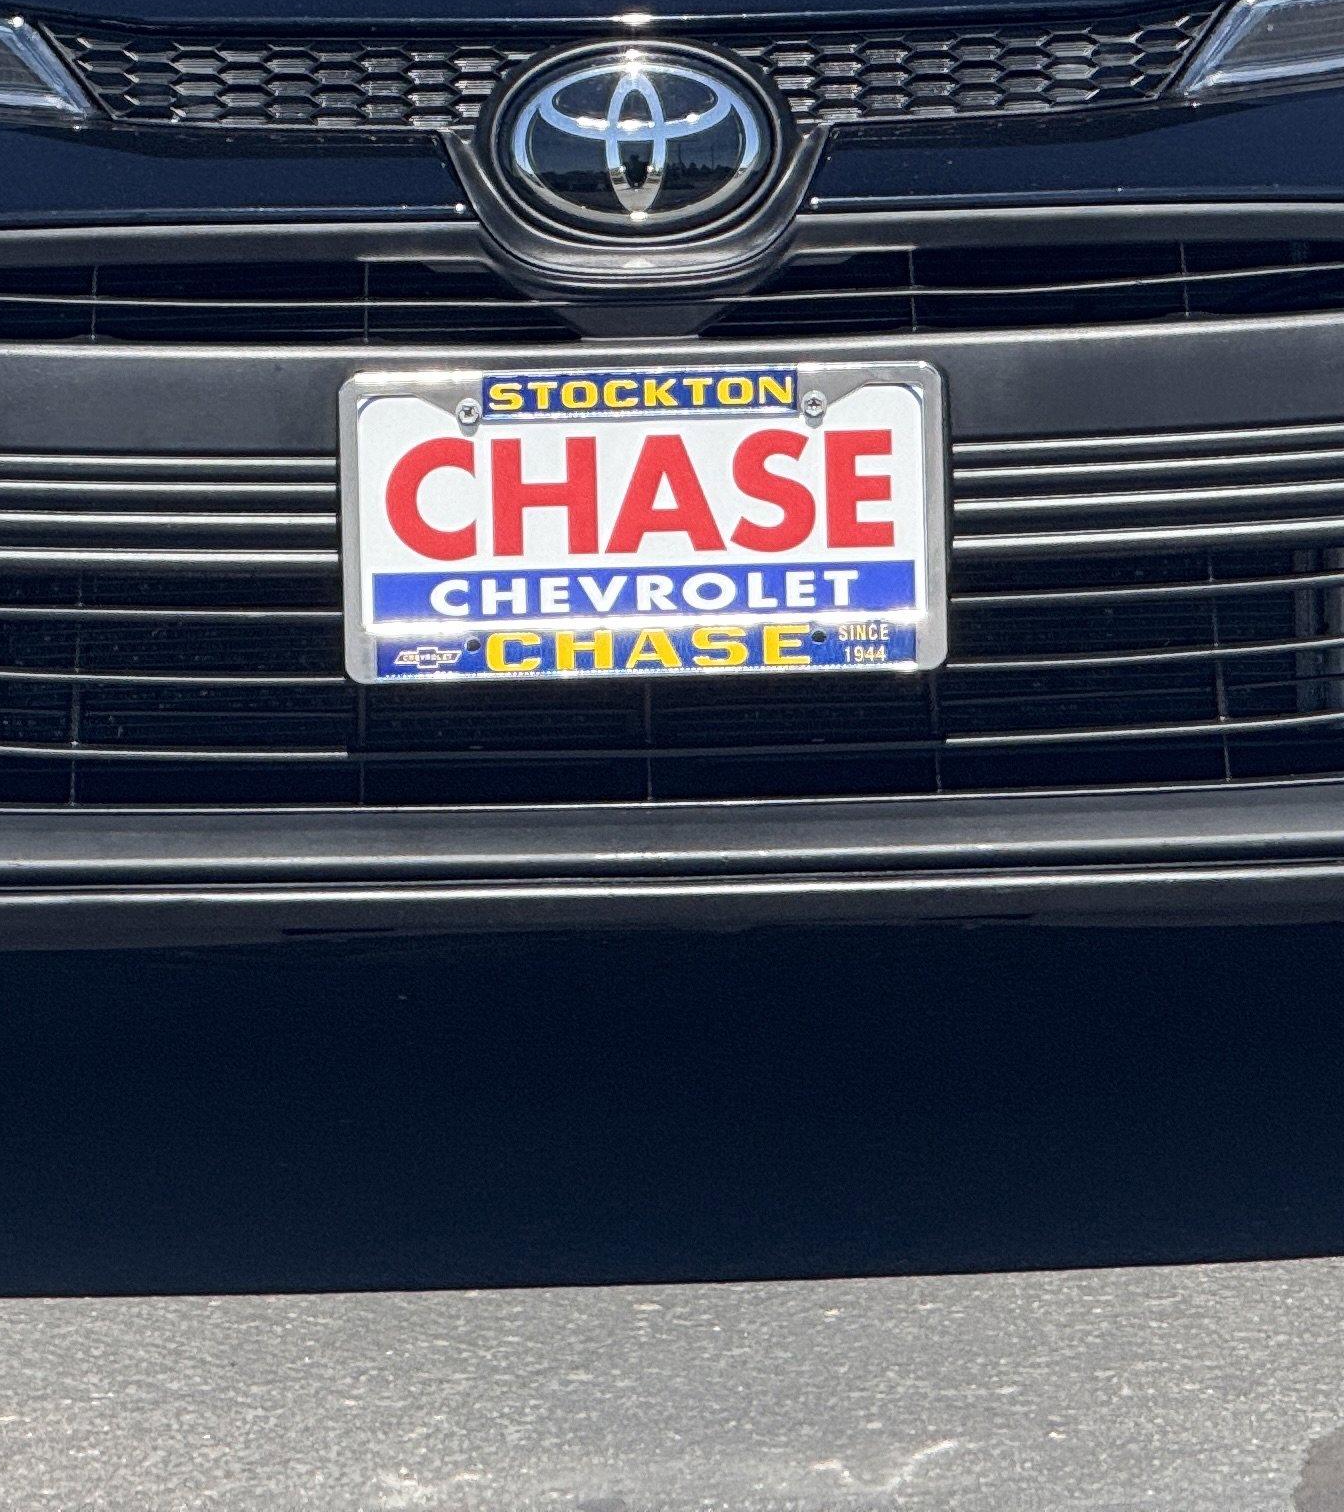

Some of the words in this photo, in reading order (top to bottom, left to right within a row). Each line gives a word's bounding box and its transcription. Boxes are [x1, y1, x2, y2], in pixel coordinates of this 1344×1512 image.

[488, 376, 794, 412] STOCKTON
[385, 428, 896, 562] CHASE
[429, 570, 860, 616] CHEVROLET
[486, 624, 812, 674] CHASE
[837, 623, 890, 642] SINCE
[843, 645, 887, 663] 1944
